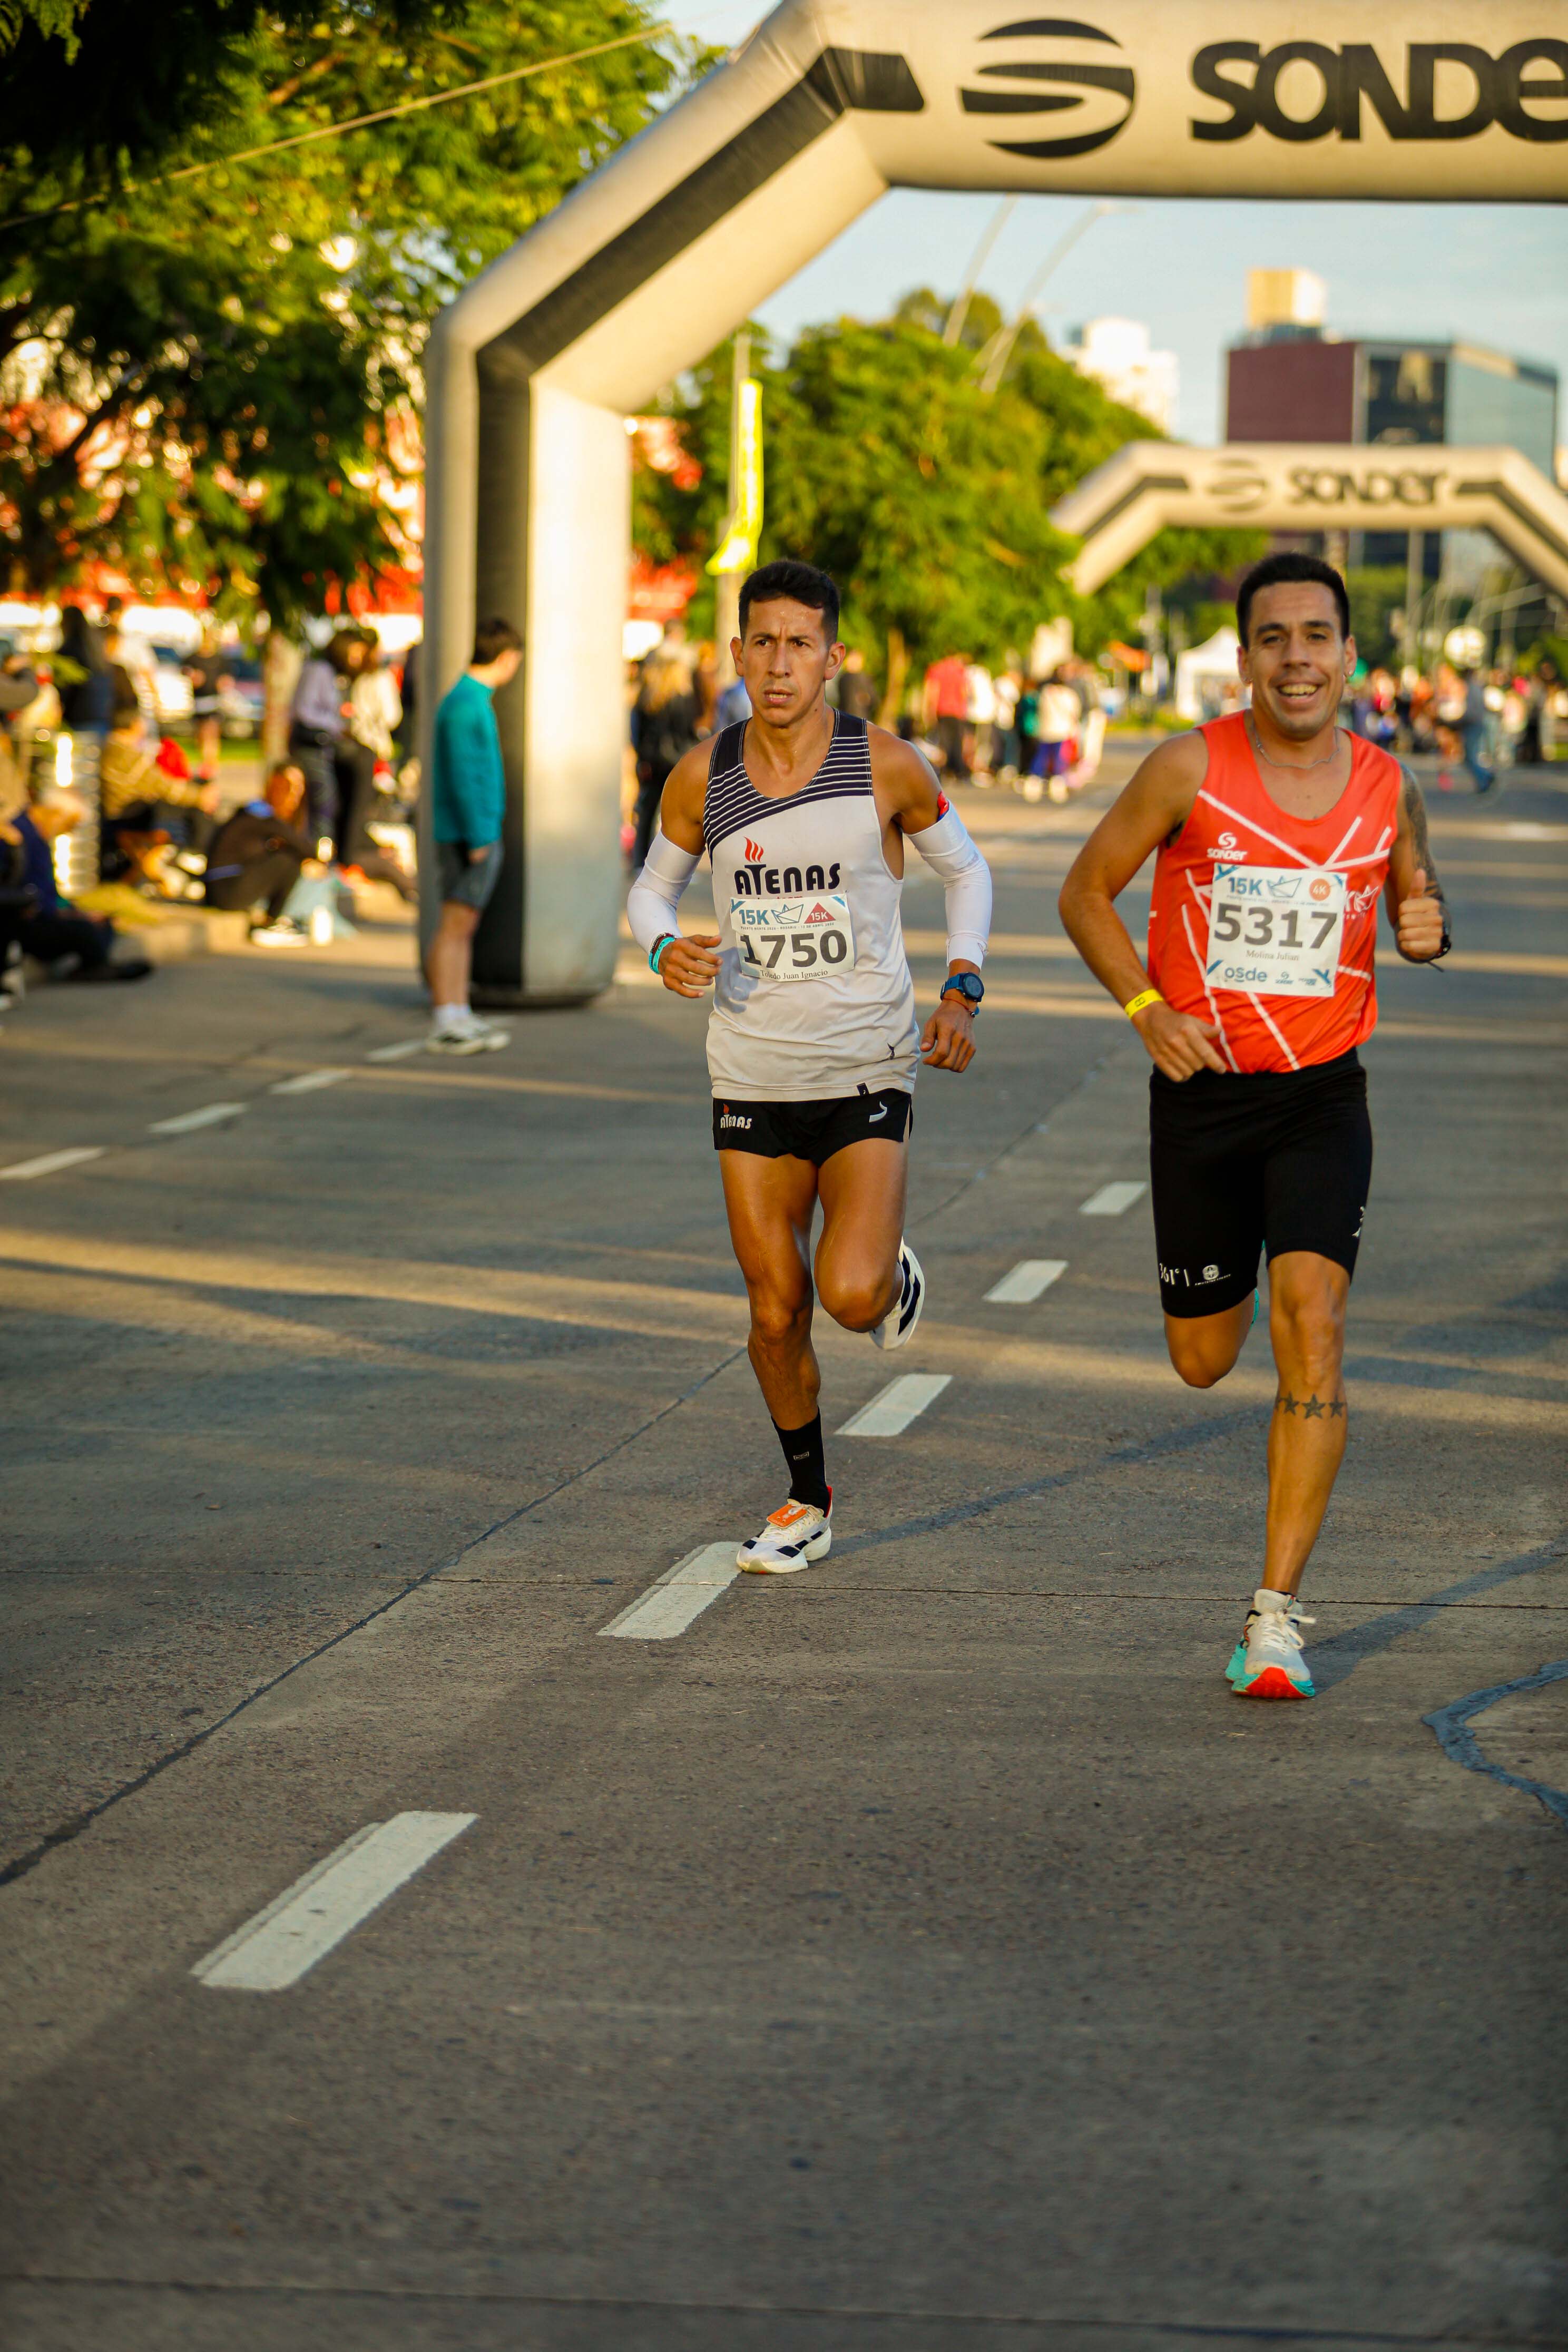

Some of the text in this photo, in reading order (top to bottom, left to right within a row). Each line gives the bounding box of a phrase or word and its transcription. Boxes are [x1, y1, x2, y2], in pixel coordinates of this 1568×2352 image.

[1228, 877, 1263, 896] 15K
[739, 909, 770, 925] 15K
[810, 912, 829, 921] 15K
[1213, 903, 1338, 949] 5317
[740, 929, 847, 968] 1750
[1246, 949, 1275, 959] Molina
[760, 969, 781, 979] Toledo
[801, 969, 828, 979] Ignacio
[1224, 966, 1268, 982] osde
